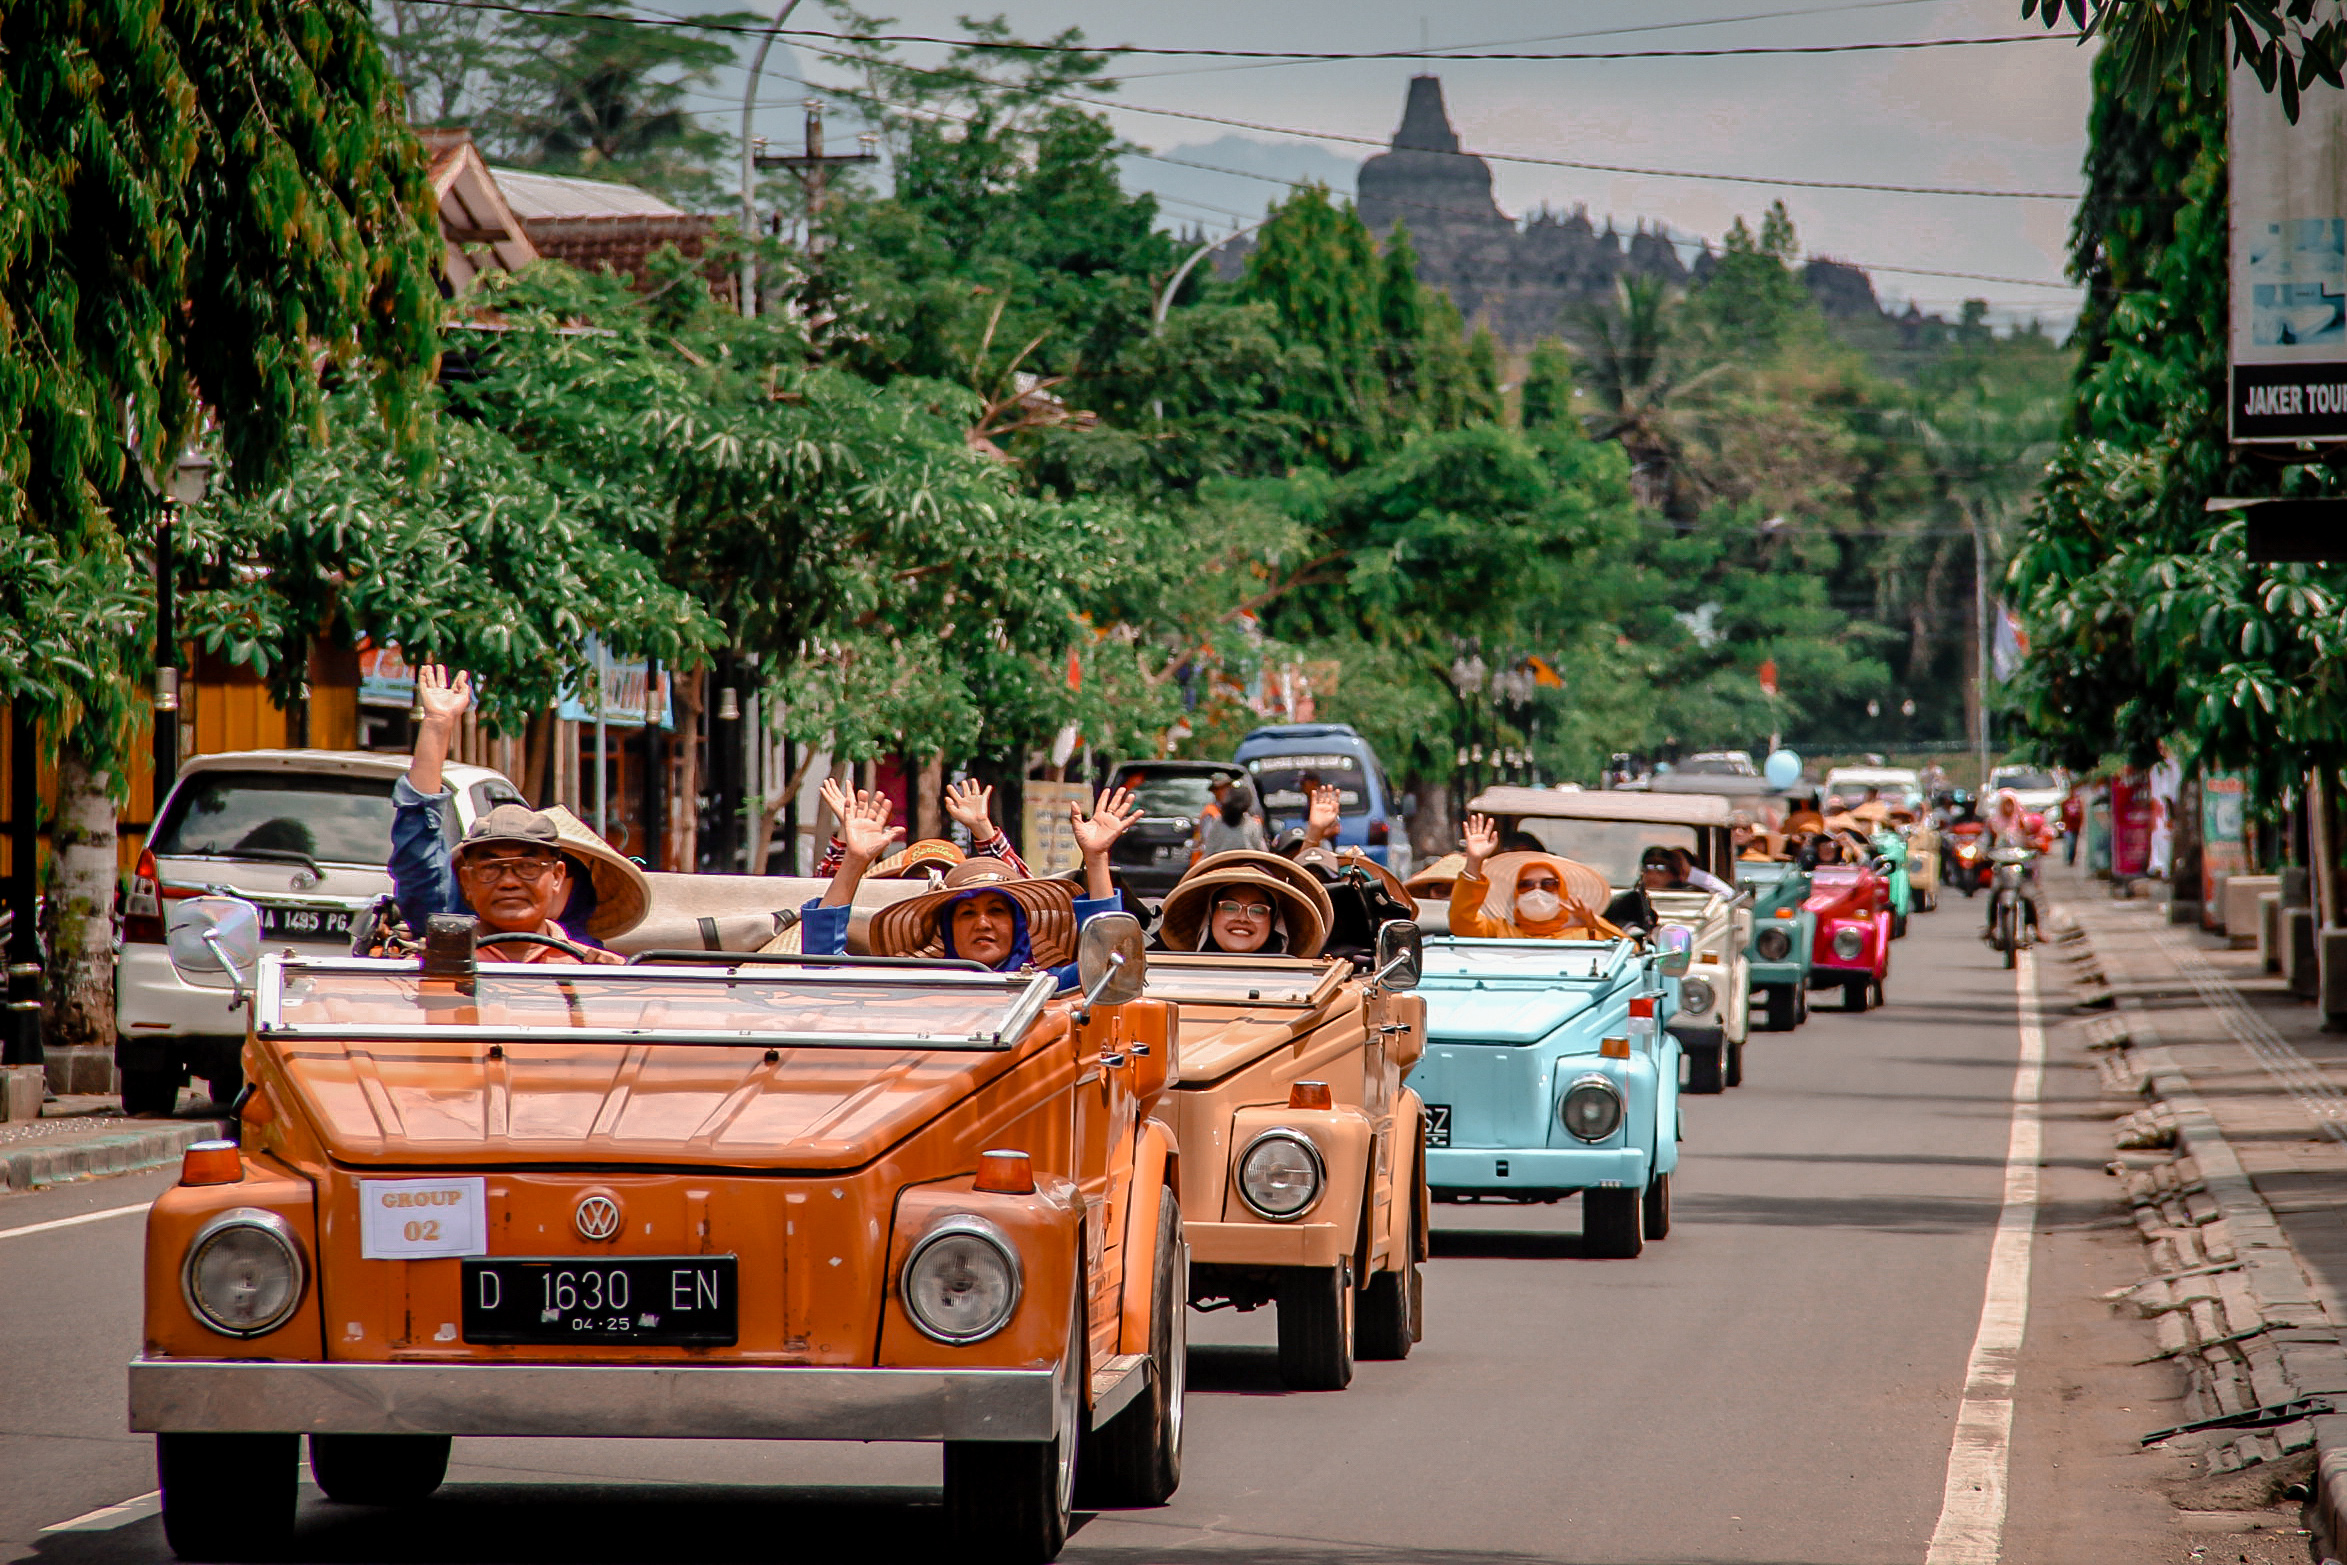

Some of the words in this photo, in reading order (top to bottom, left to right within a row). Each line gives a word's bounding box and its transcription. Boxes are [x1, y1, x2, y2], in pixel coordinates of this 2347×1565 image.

[2244, 384, 2303, 416] JAKER
[283, 909, 319, 932] 1495
[325, 912, 348, 932] PG
[381, 1190, 462, 1208] GROUP
[403, 1219, 441, 1242] 02
[479, 1270, 501, 1309] D
[541, 1269, 629, 1310] 1630
[671, 1269, 719, 1310] EN
